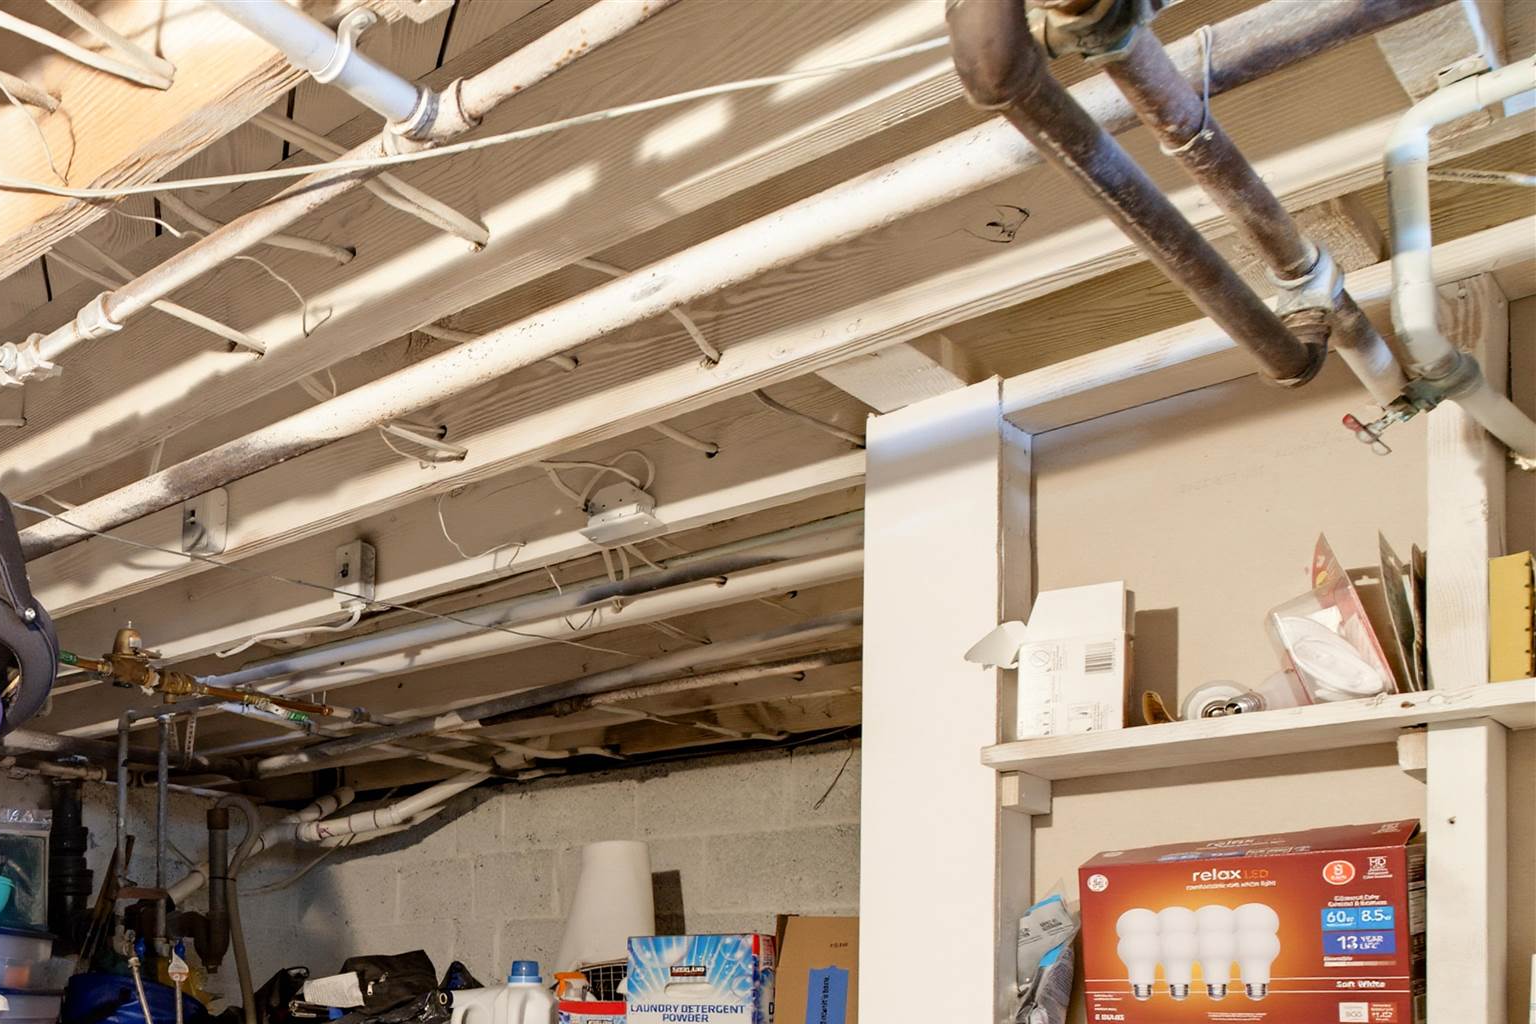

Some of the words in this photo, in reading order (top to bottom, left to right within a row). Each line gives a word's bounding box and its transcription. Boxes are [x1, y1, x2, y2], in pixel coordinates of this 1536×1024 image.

[1192, 868, 1241, 882] relax
[1337, 935, 1358, 950] 13
[630, 1003, 679, 1013] LAUNDRY
[681, 1004, 745, 1014] DETERGENT
[662, 1013, 709, 1022] POWDER
